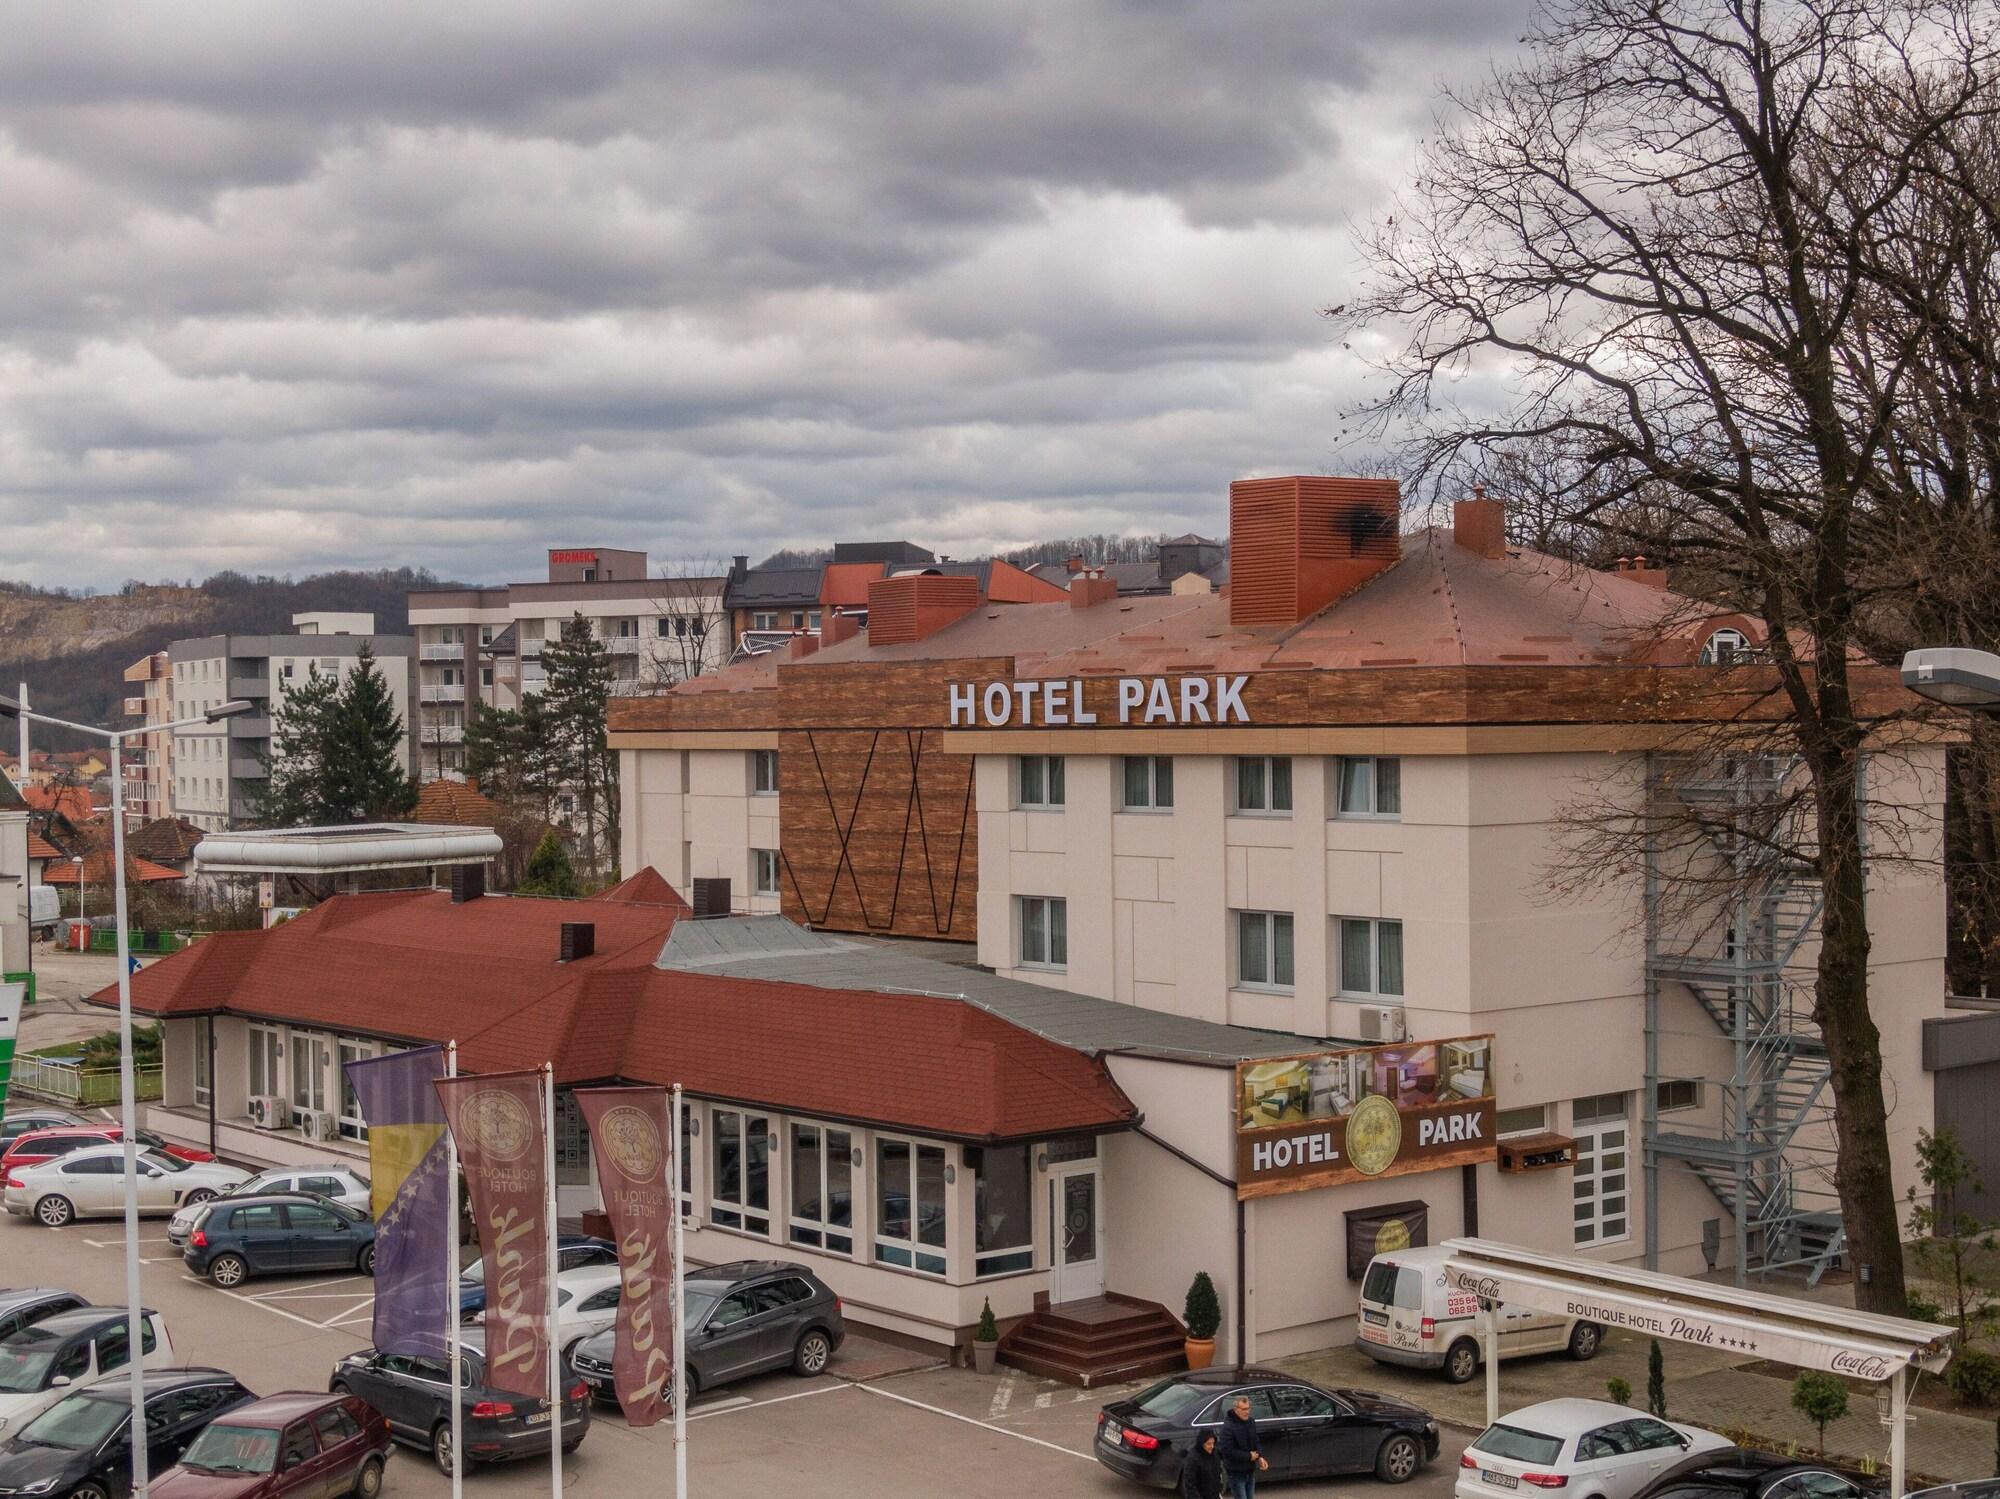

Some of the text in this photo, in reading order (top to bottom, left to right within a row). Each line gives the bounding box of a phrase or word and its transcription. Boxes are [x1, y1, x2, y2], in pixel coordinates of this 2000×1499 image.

[949, 676, 1250, 726] HOTEL PARK
[1253, 1111, 1482, 1171] HOTEL PARK
[1448, 1297, 1465, 1306] 035
[1448, 1305, 1465, 1315] 062
[1567, 1302, 1714, 1344] BOUTIQUE HOTEL Park
[1393, 1333, 1419, 1349] Park
